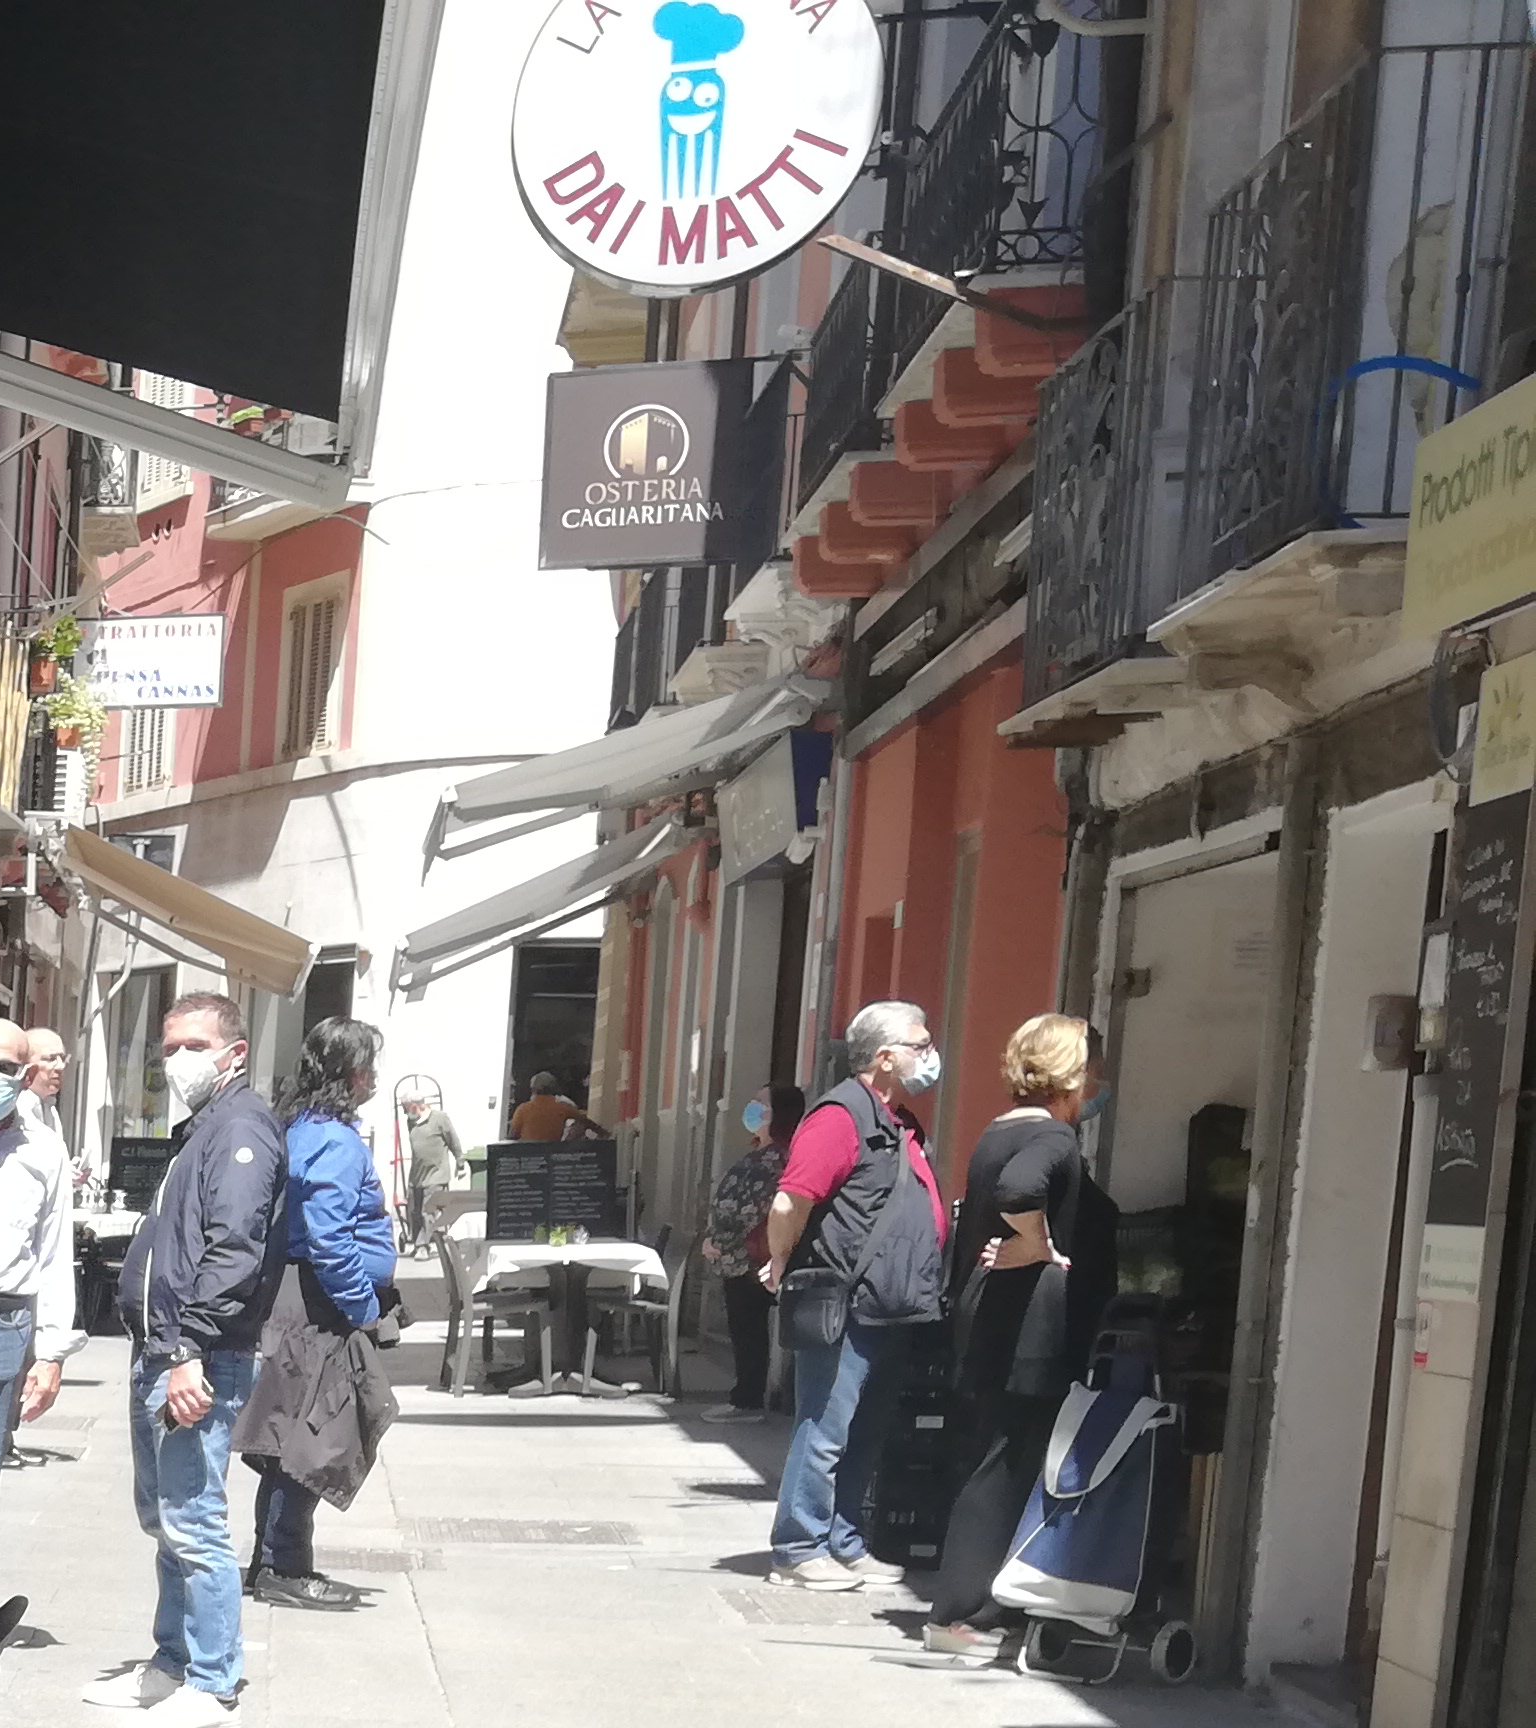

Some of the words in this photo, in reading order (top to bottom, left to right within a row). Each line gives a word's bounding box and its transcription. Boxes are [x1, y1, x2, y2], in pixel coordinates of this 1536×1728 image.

[542, 149, 647, 255] DAI
[658, 128, 849, 266] MATTI
[584, 477, 703, 506] OSTERIA
[1419, 436, 1497, 530] Prodotti
[97, 623, 217, 640] TRATTORIA
[137, 683, 215, 699] CANNAS
